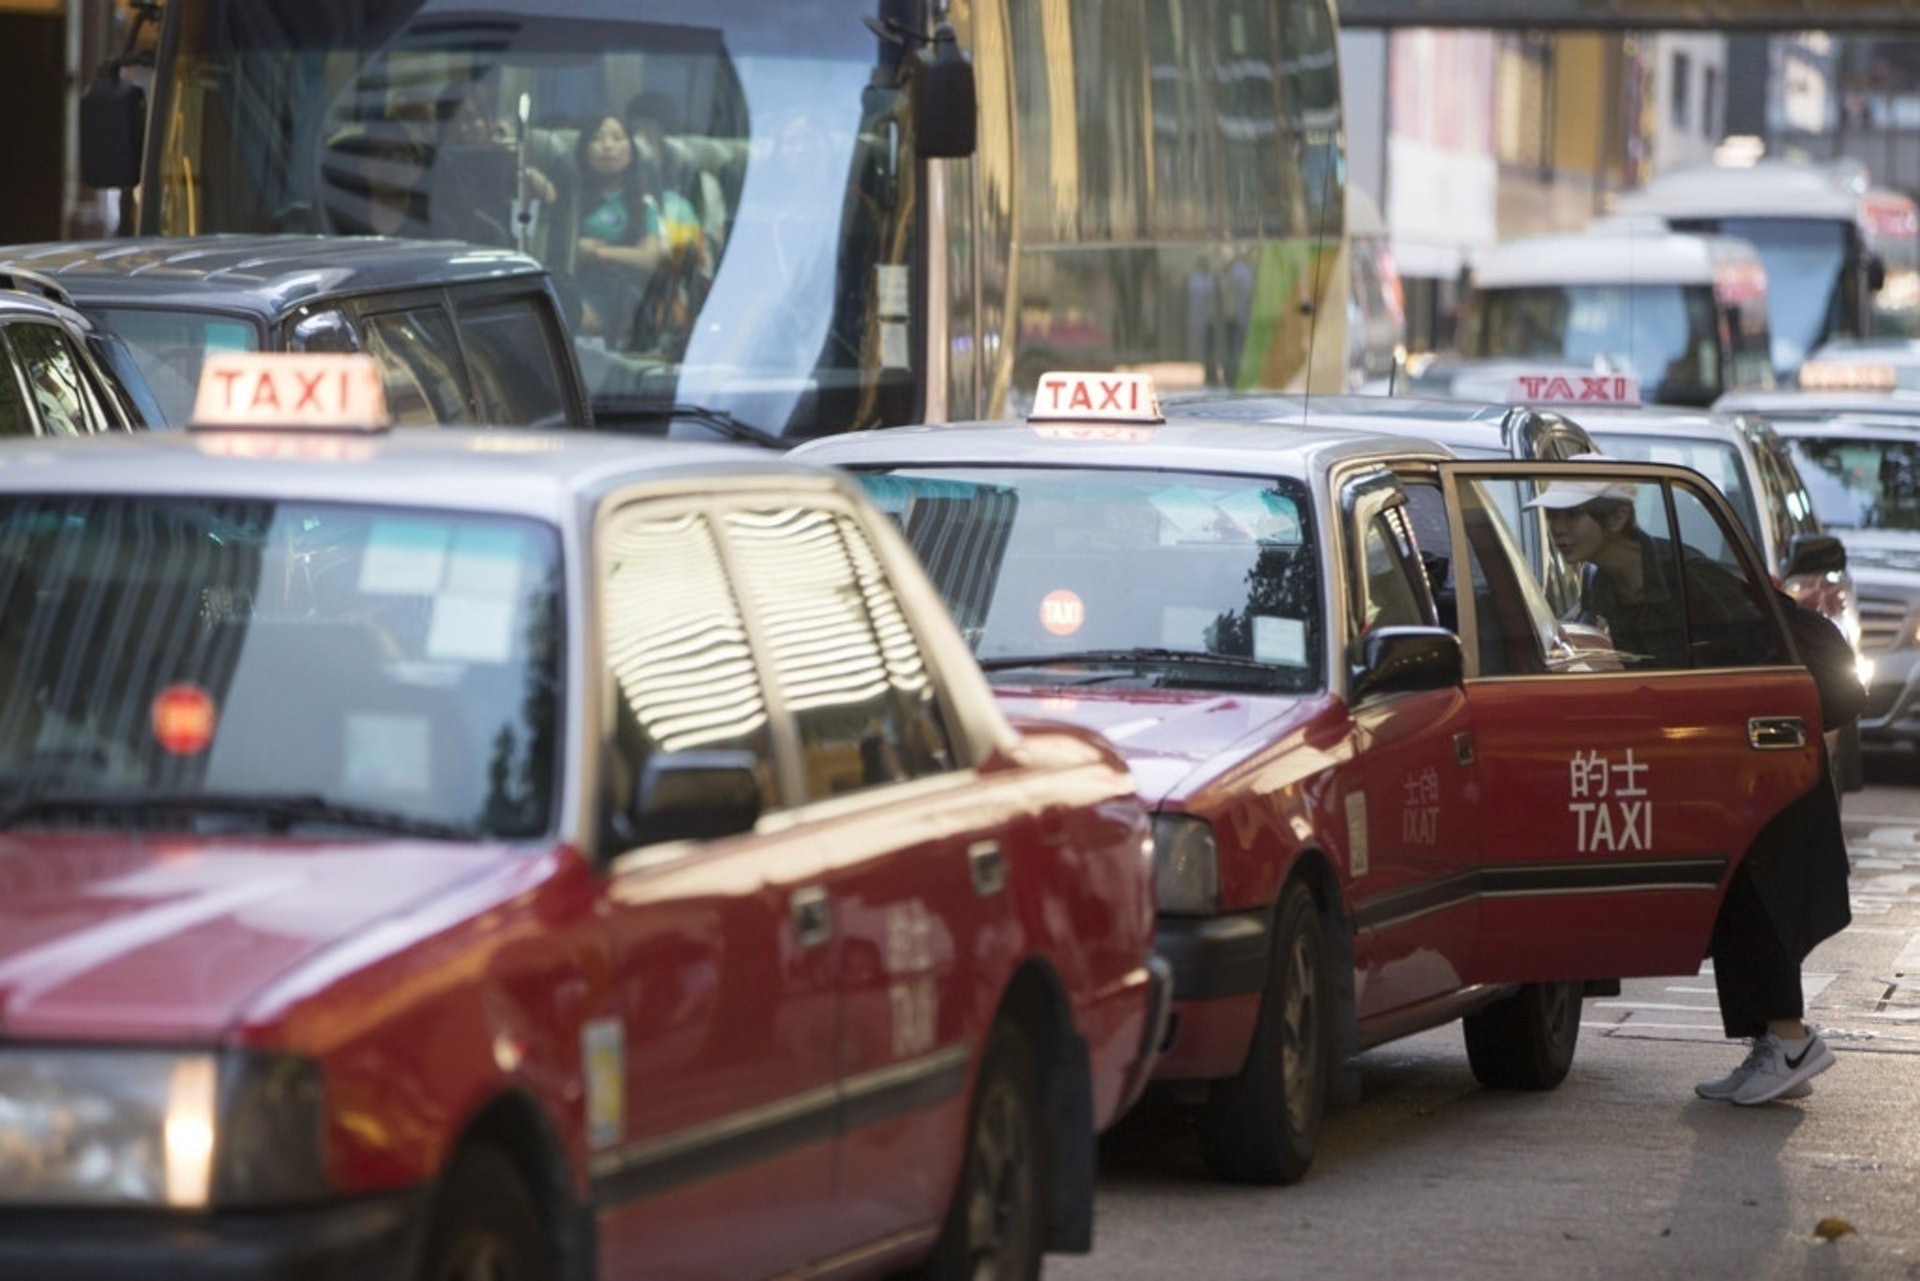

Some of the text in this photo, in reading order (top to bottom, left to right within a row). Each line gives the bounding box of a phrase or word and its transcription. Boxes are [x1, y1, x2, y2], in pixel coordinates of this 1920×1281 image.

[214, 369, 349, 411] TAXI
[1045, 381, 1137, 410] TAXI
[1518, 376, 1626, 400] TAXI
[1570, 748, 1649, 798] 的士
[1568, 801, 1652, 852] TAXI
